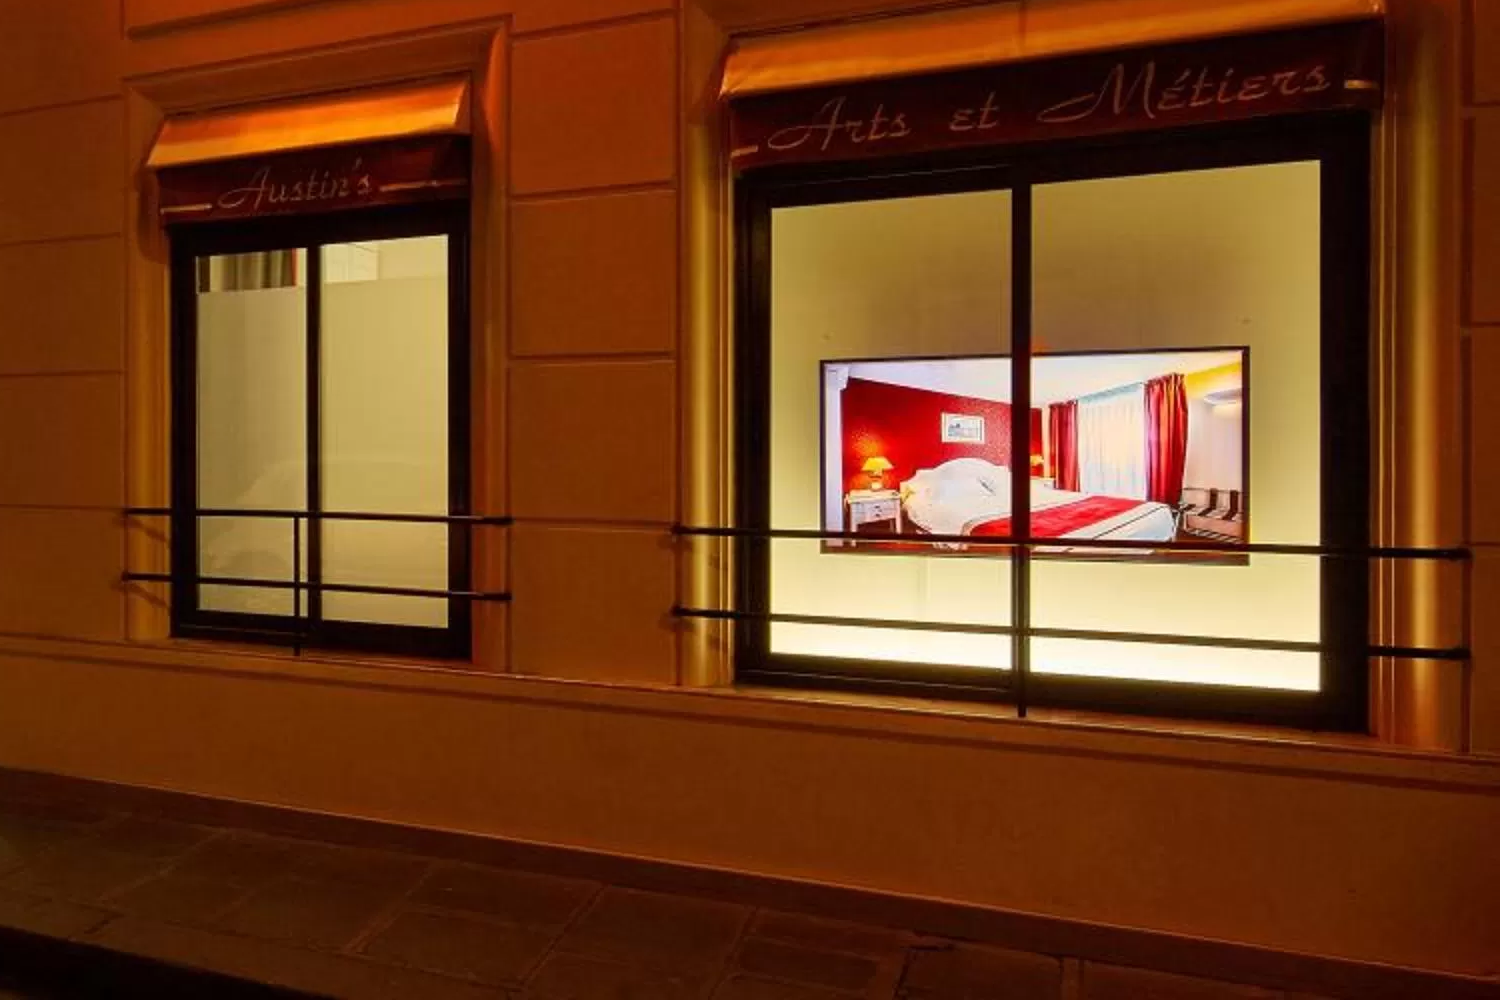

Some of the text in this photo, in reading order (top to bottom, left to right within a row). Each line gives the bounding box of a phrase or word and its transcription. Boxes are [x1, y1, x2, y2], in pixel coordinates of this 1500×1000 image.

[767, 60, 1332, 151] Arts et Métiers
[216, 156, 373, 212] Austin's
